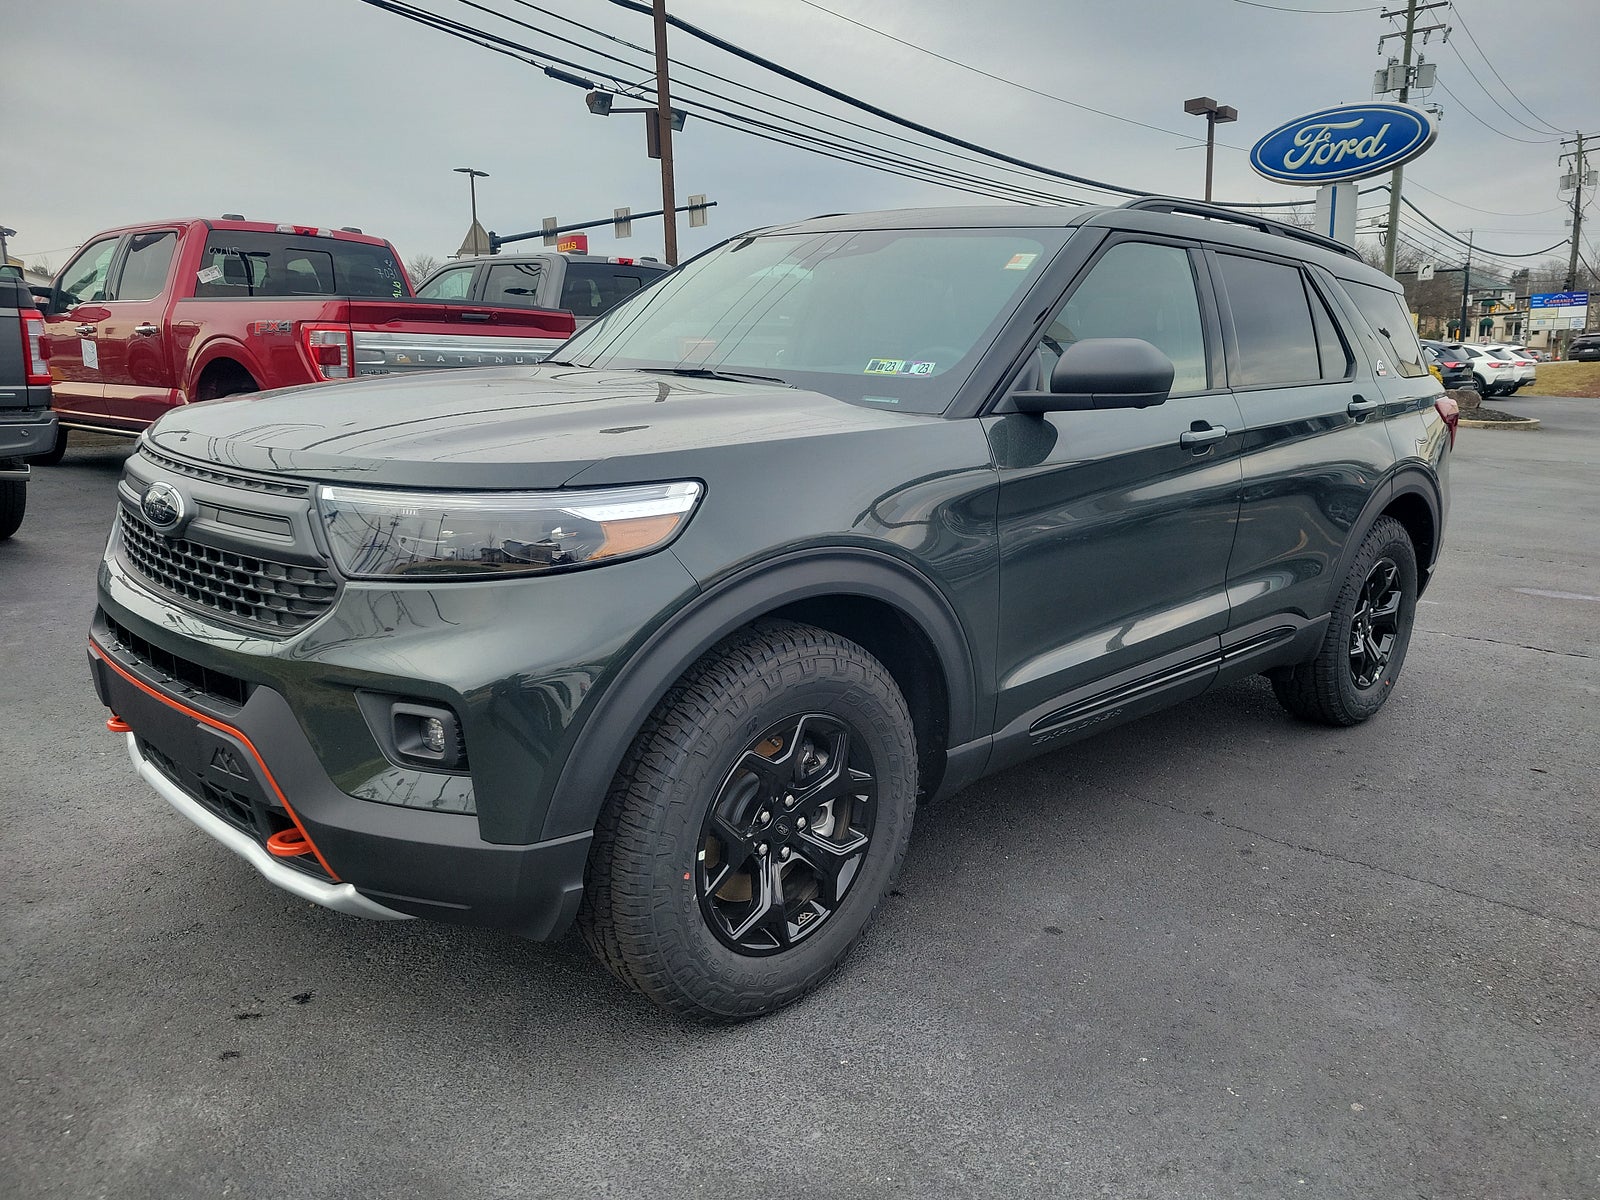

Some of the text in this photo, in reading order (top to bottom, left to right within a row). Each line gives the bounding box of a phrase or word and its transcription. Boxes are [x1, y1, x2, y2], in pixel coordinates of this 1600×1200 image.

[1283, 118, 1391, 170] Ford
[254, 320, 292, 336] FX4
[885, 361, 897, 372] 23
[918, 363, 930, 374] 23
